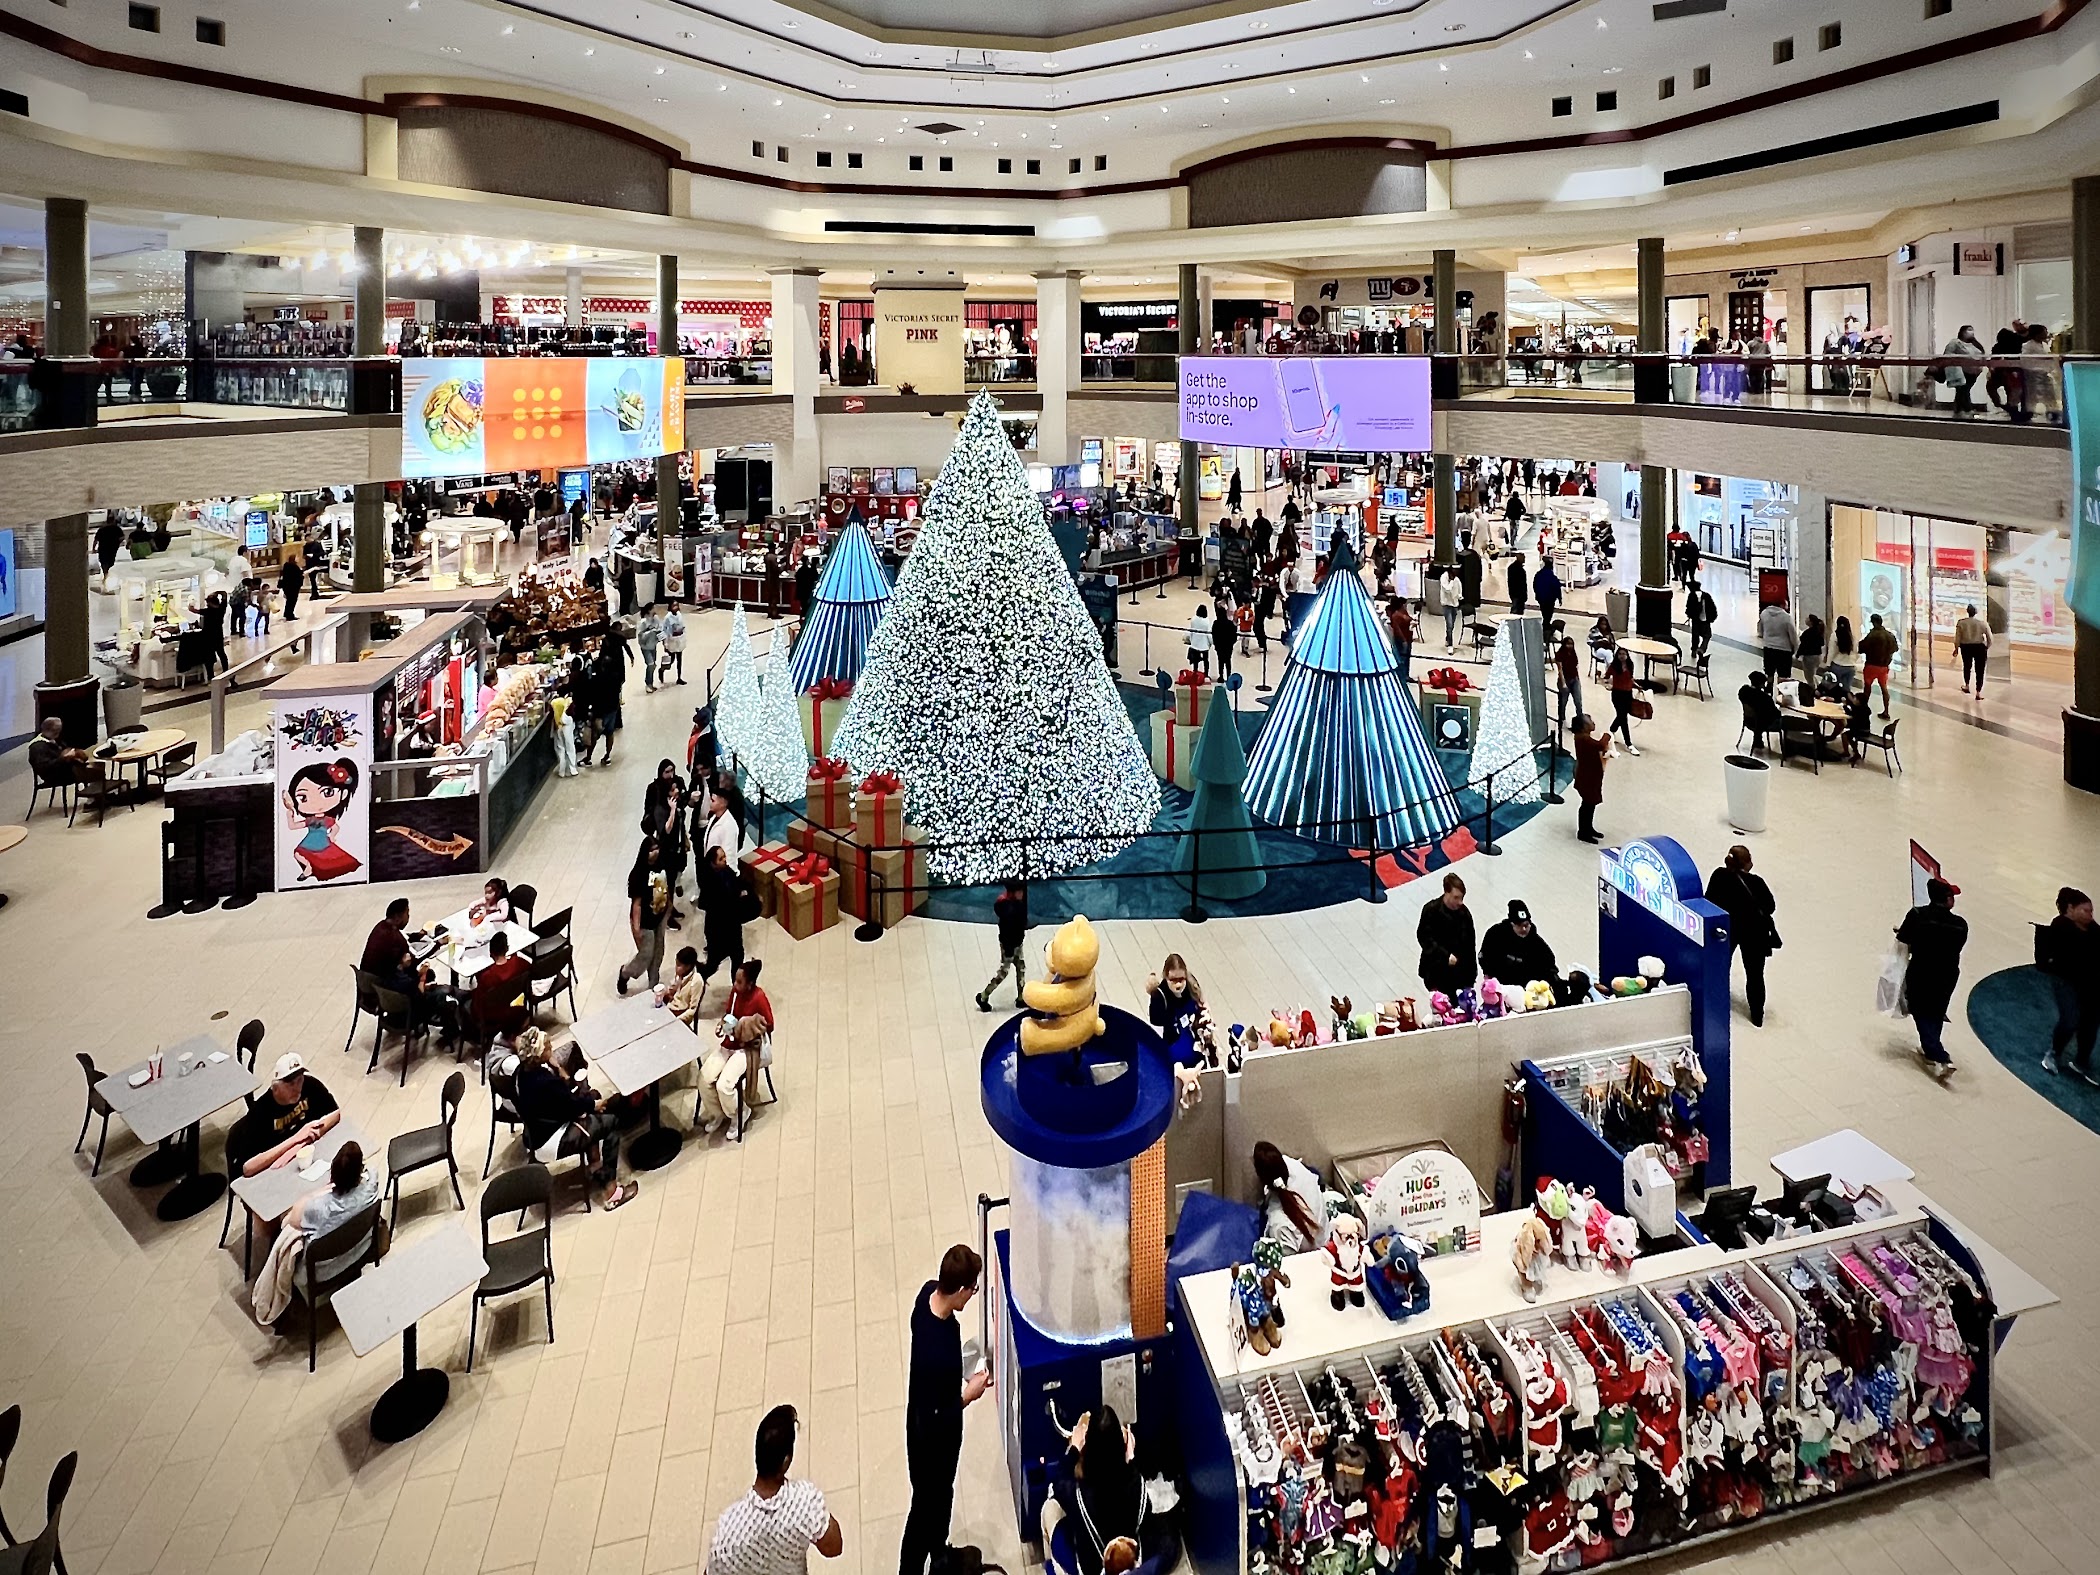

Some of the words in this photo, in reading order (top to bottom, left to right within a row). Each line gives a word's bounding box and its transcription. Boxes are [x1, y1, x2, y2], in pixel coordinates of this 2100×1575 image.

[885, 314, 928, 322] VICTORIA'S
[931, 315, 959, 323] SECRET
[1099, 306, 1144, 317] VICTORIA'S
[1146, 305, 1177, 315] SECRET
[906, 329, 938, 340] PINK
[1186, 372, 1204, 388] Get
[1206, 373, 1227, 389] the
[1186, 393, 1205, 408] app
[1208, 393, 1220, 407] to
[1222, 391, 1258, 410] shop
[1186, 407, 1233, 427] in-store.
[455, 479, 474, 488] VANS
[1764, 585, 1778, 593] 50
[1600, 855, 1699, 936] WORKSHOP
[1406, 1175, 1440, 1194] HUGS
[1400, 1198, 1446, 1216] HOLIDAYS
